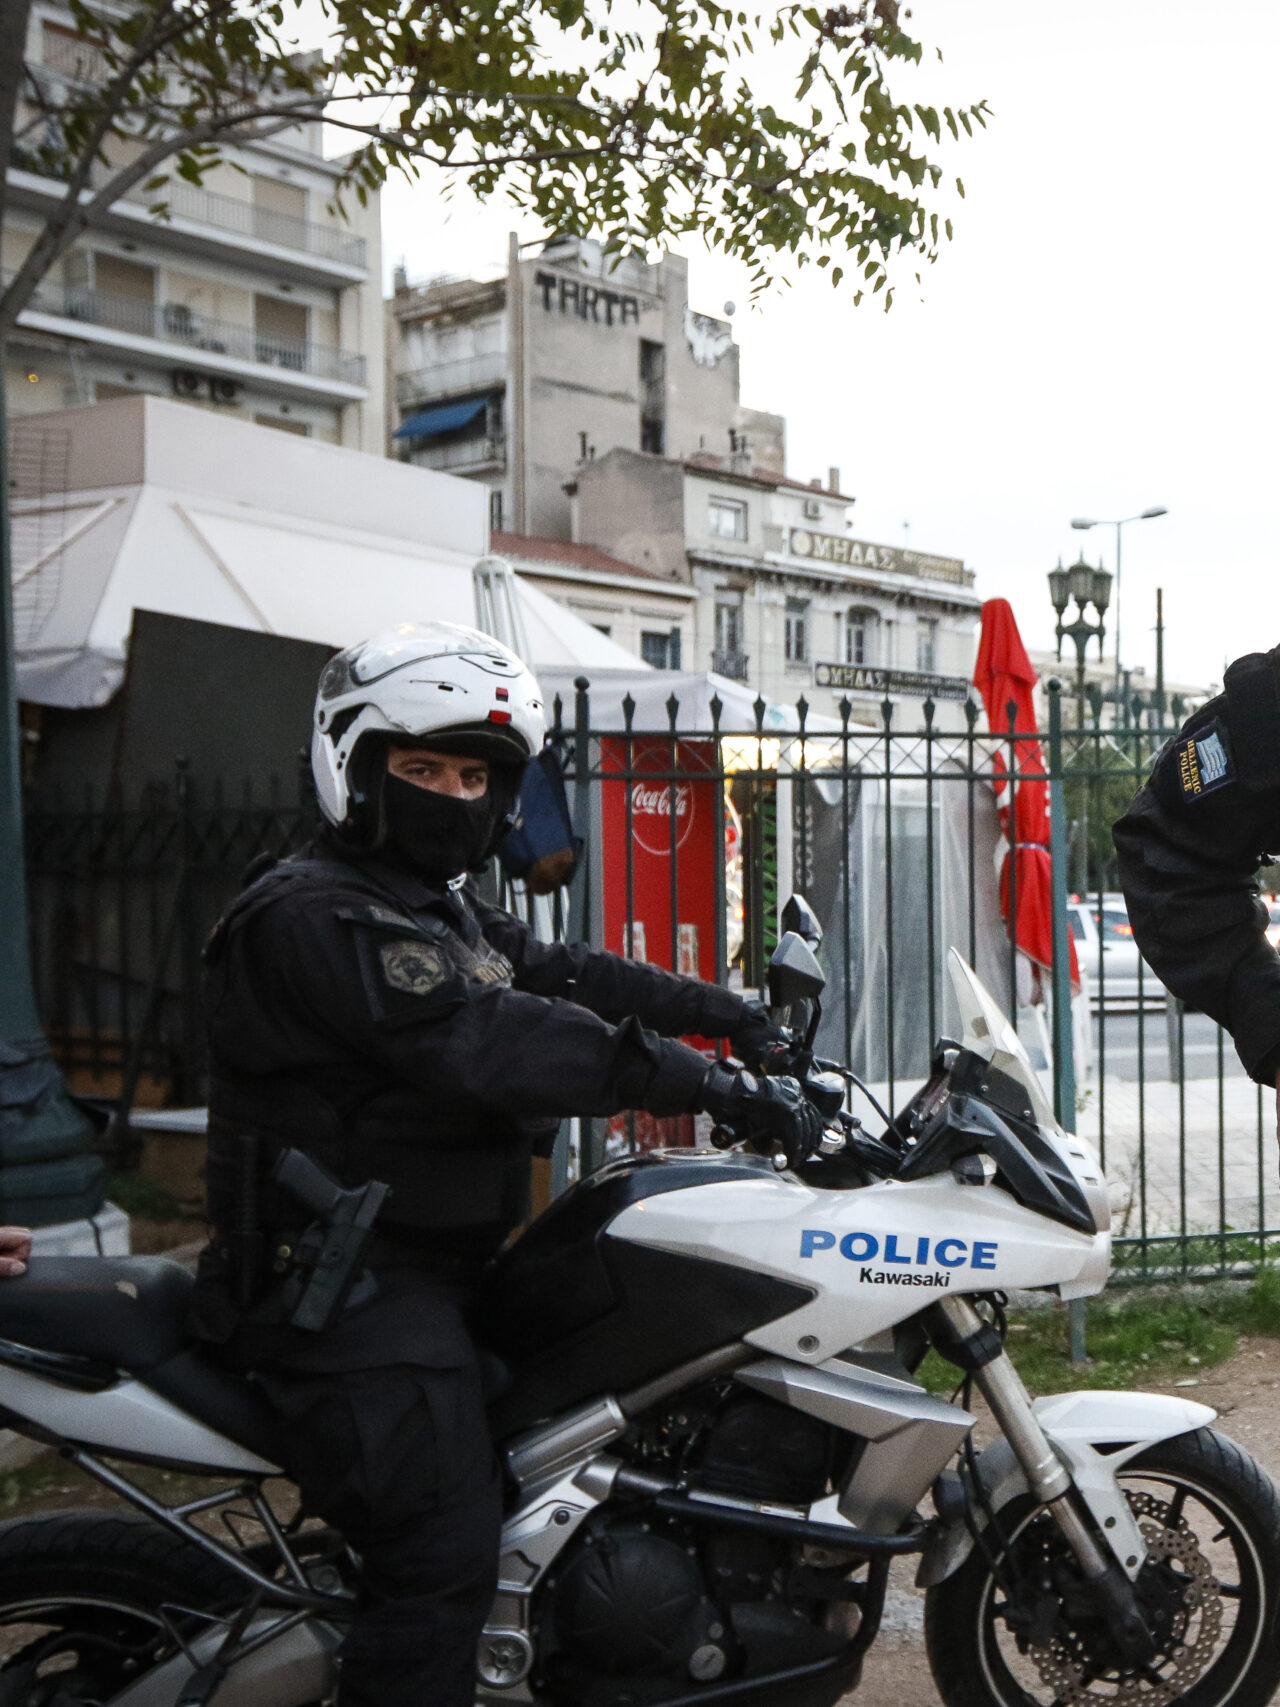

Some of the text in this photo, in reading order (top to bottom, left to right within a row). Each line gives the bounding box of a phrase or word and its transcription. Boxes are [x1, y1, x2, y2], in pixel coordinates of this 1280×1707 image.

[813, 534, 897, 571] ΜΗΔΑΣ
[830, 665, 887, 690] ΜΗΔΑΣ
[1180, 751, 1192, 791] POLICE
[1187, 740, 1201, 793] HELLENIC
[800, 1230, 998, 1270] POLICE
[859, 1267, 951, 1288] Kawasaki
